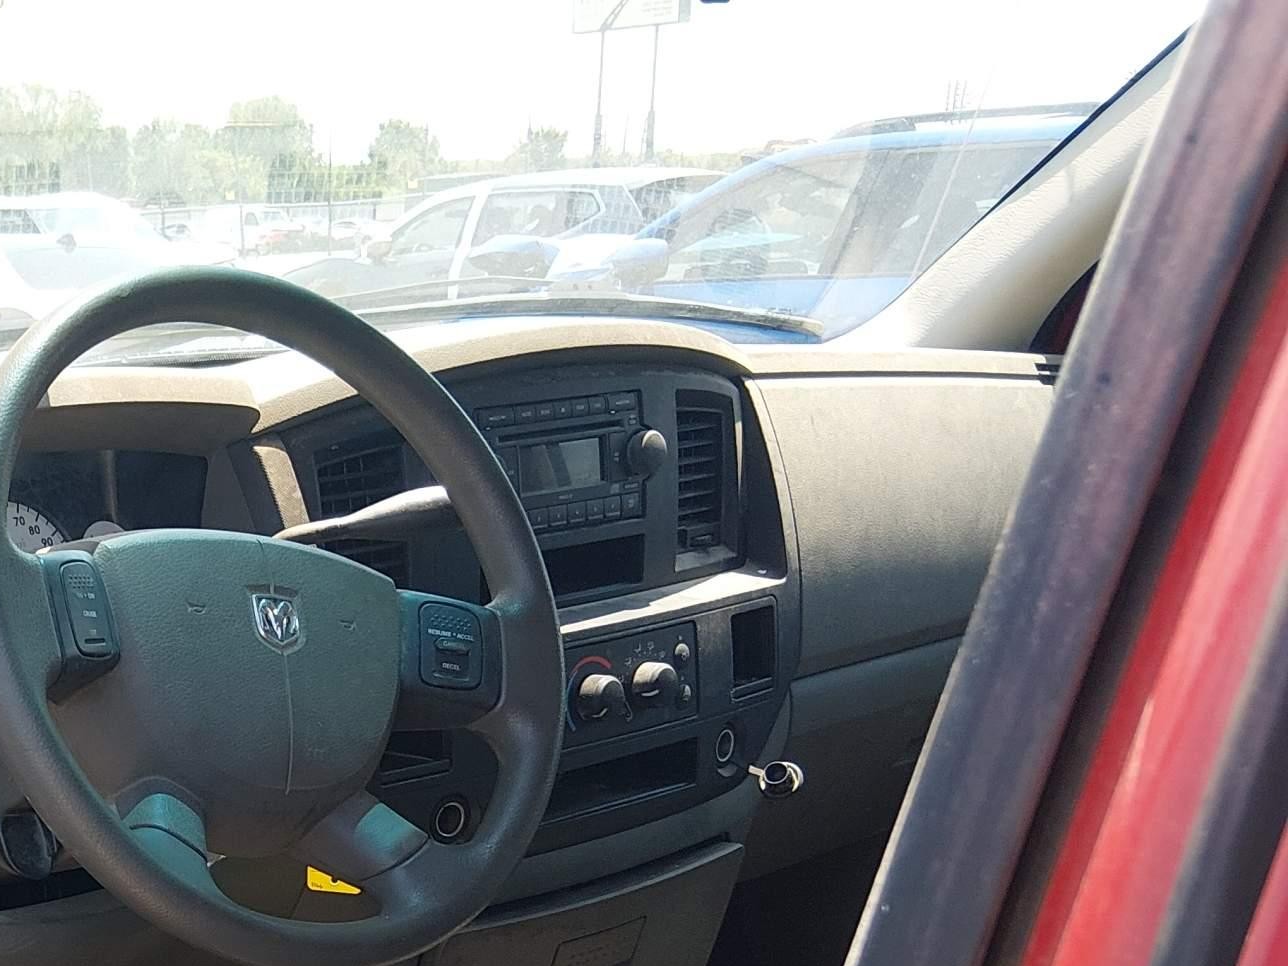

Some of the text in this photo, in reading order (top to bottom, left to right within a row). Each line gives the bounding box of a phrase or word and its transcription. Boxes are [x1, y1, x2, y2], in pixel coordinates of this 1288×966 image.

[12, 516, 26, 527] 70
[28, 525, 41, 536] 80
[41, 537, 54, 547] 90
